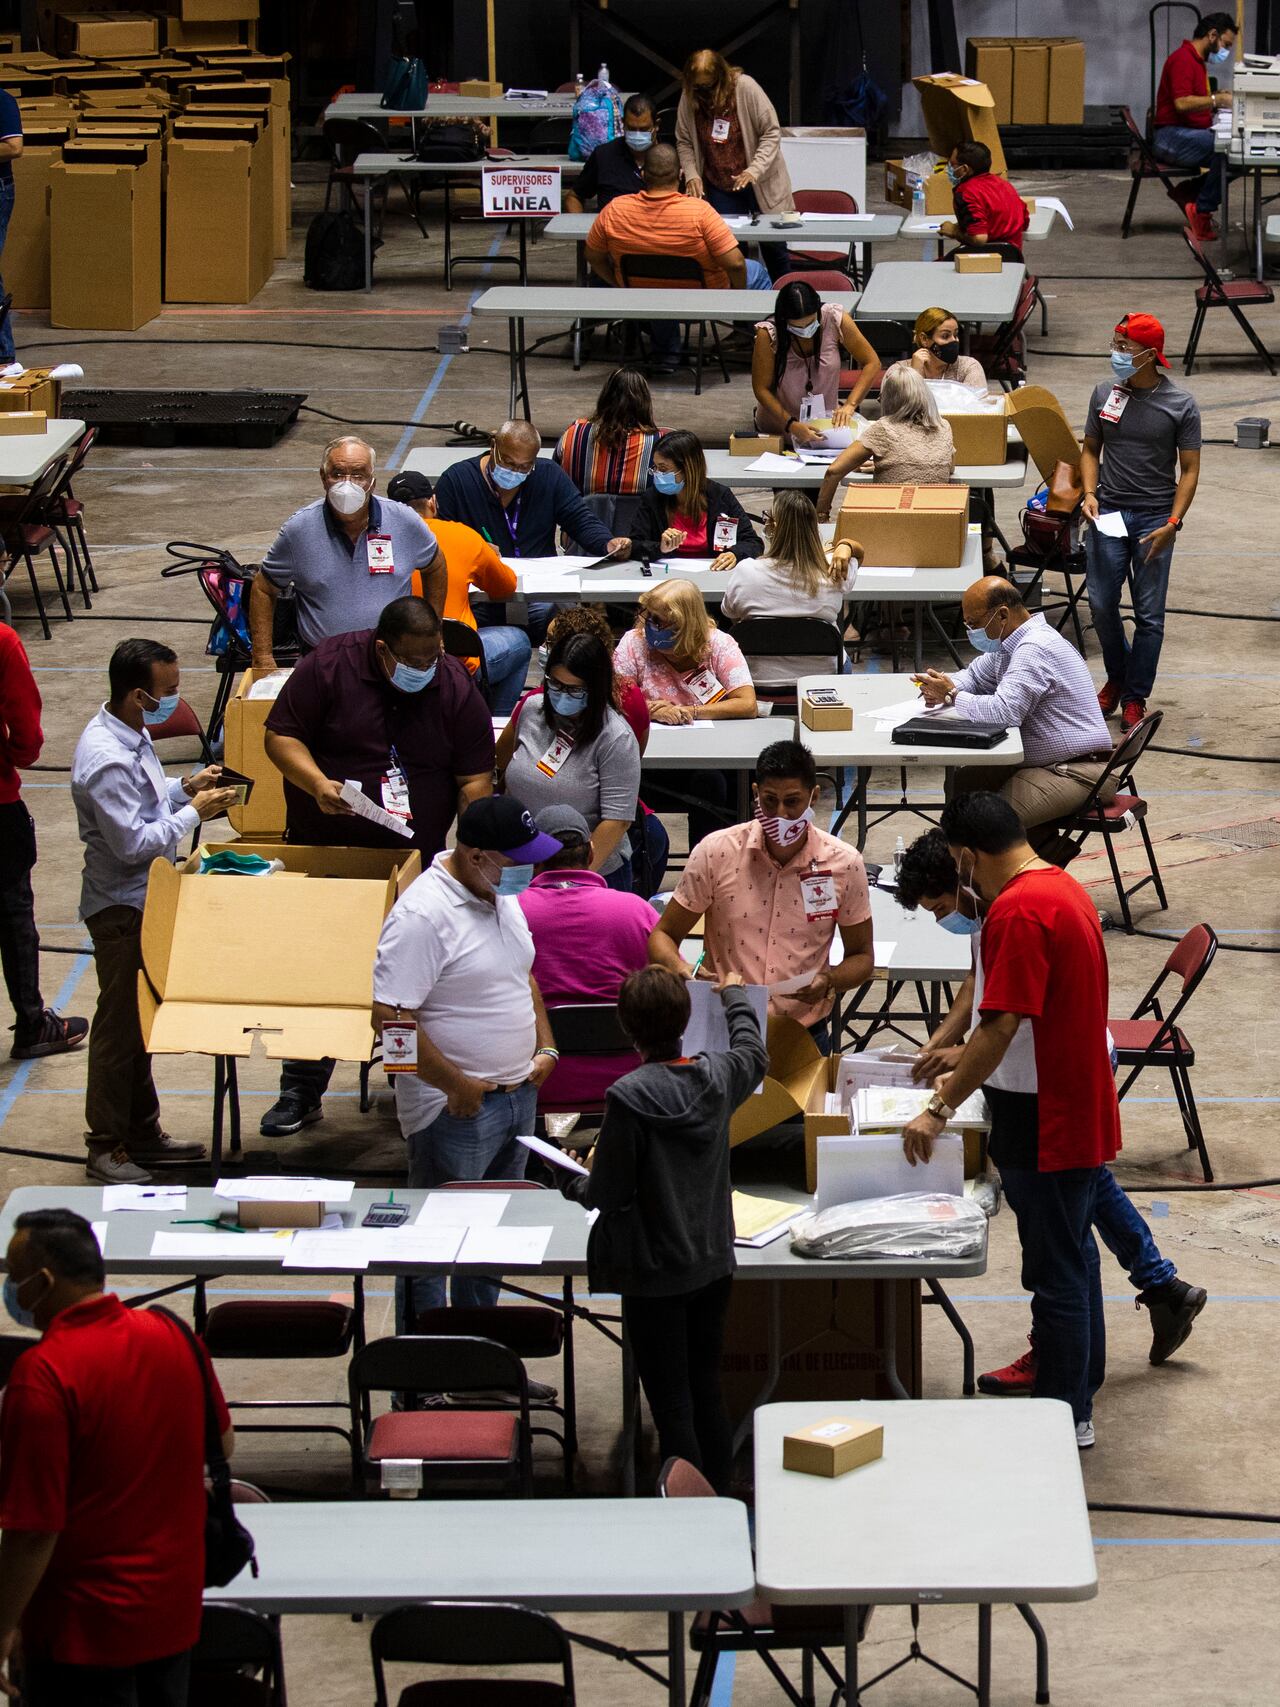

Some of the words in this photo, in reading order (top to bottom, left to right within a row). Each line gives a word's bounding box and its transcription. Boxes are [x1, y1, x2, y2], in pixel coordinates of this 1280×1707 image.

[491, 174, 553, 186] SUPERVISORES
[514, 186, 530, 194] DE
[493, 196, 551, 210] LINEA
